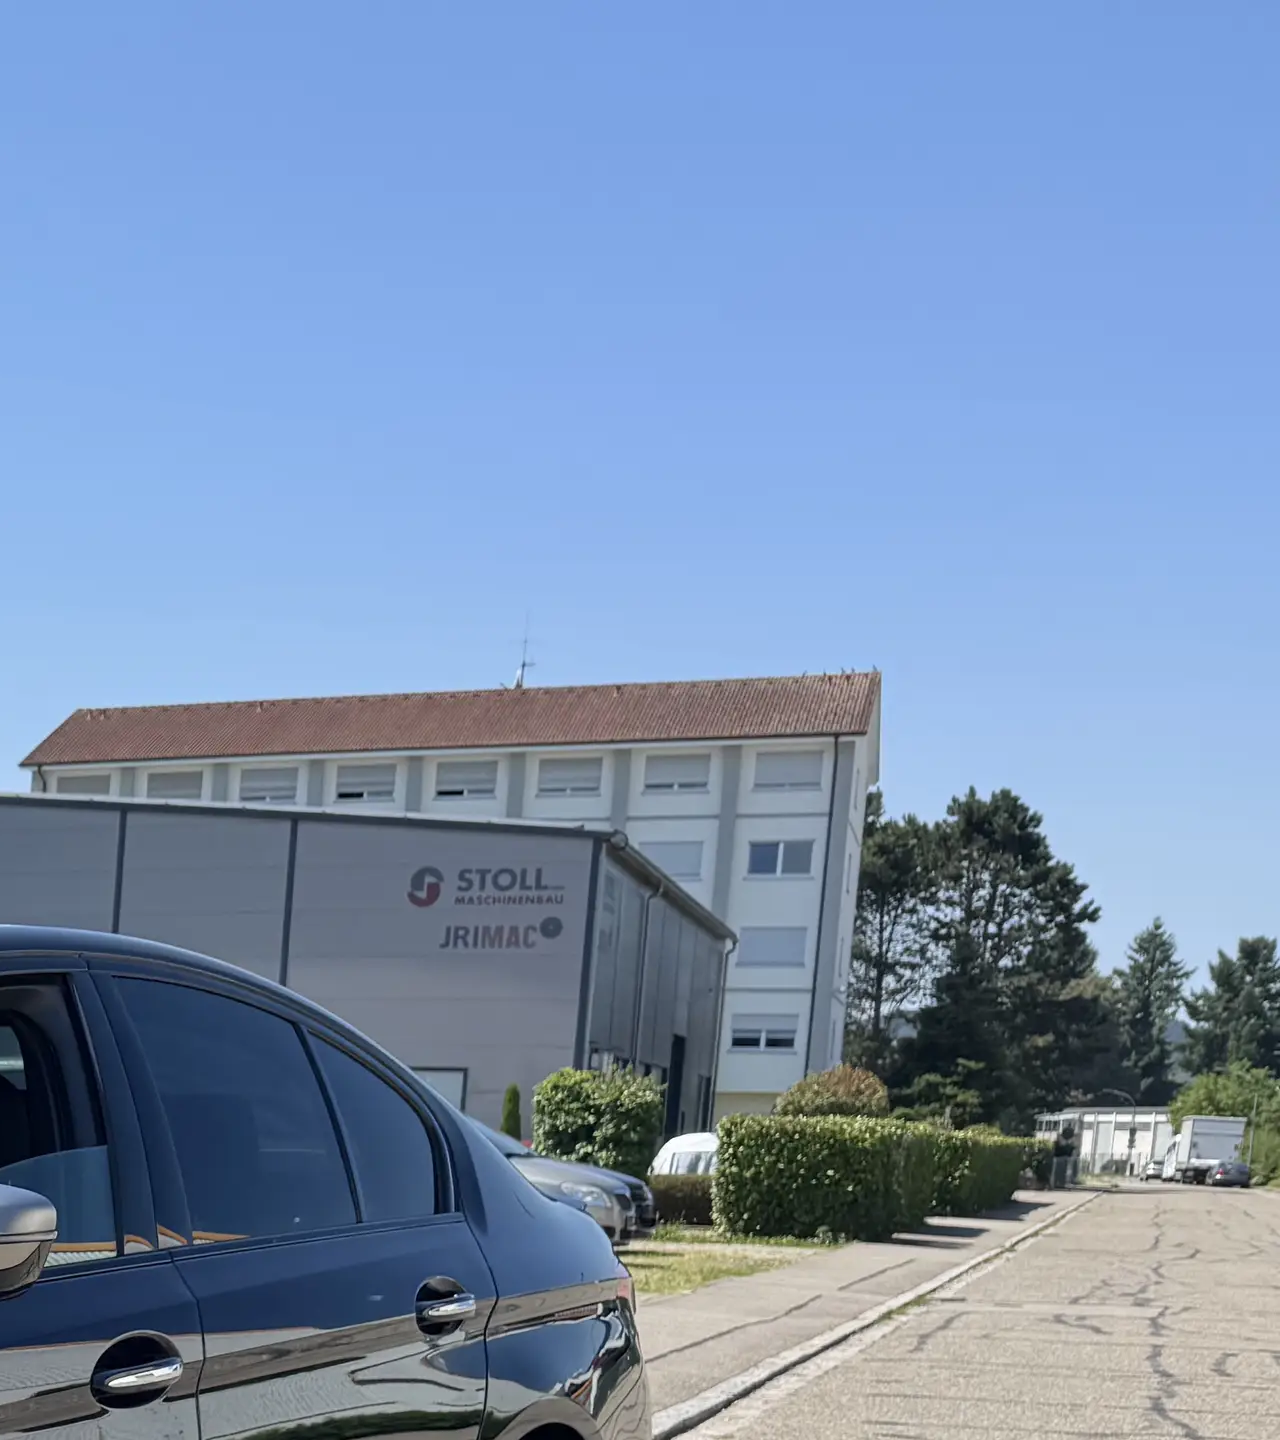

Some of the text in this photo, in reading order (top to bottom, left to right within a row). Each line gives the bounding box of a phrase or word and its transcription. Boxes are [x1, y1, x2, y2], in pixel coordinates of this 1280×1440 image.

[457, 868, 547, 892] STOLL
[454, 895, 564, 906] MASCHINENBAU
[439, 924, 537, 949] JRIMAC
